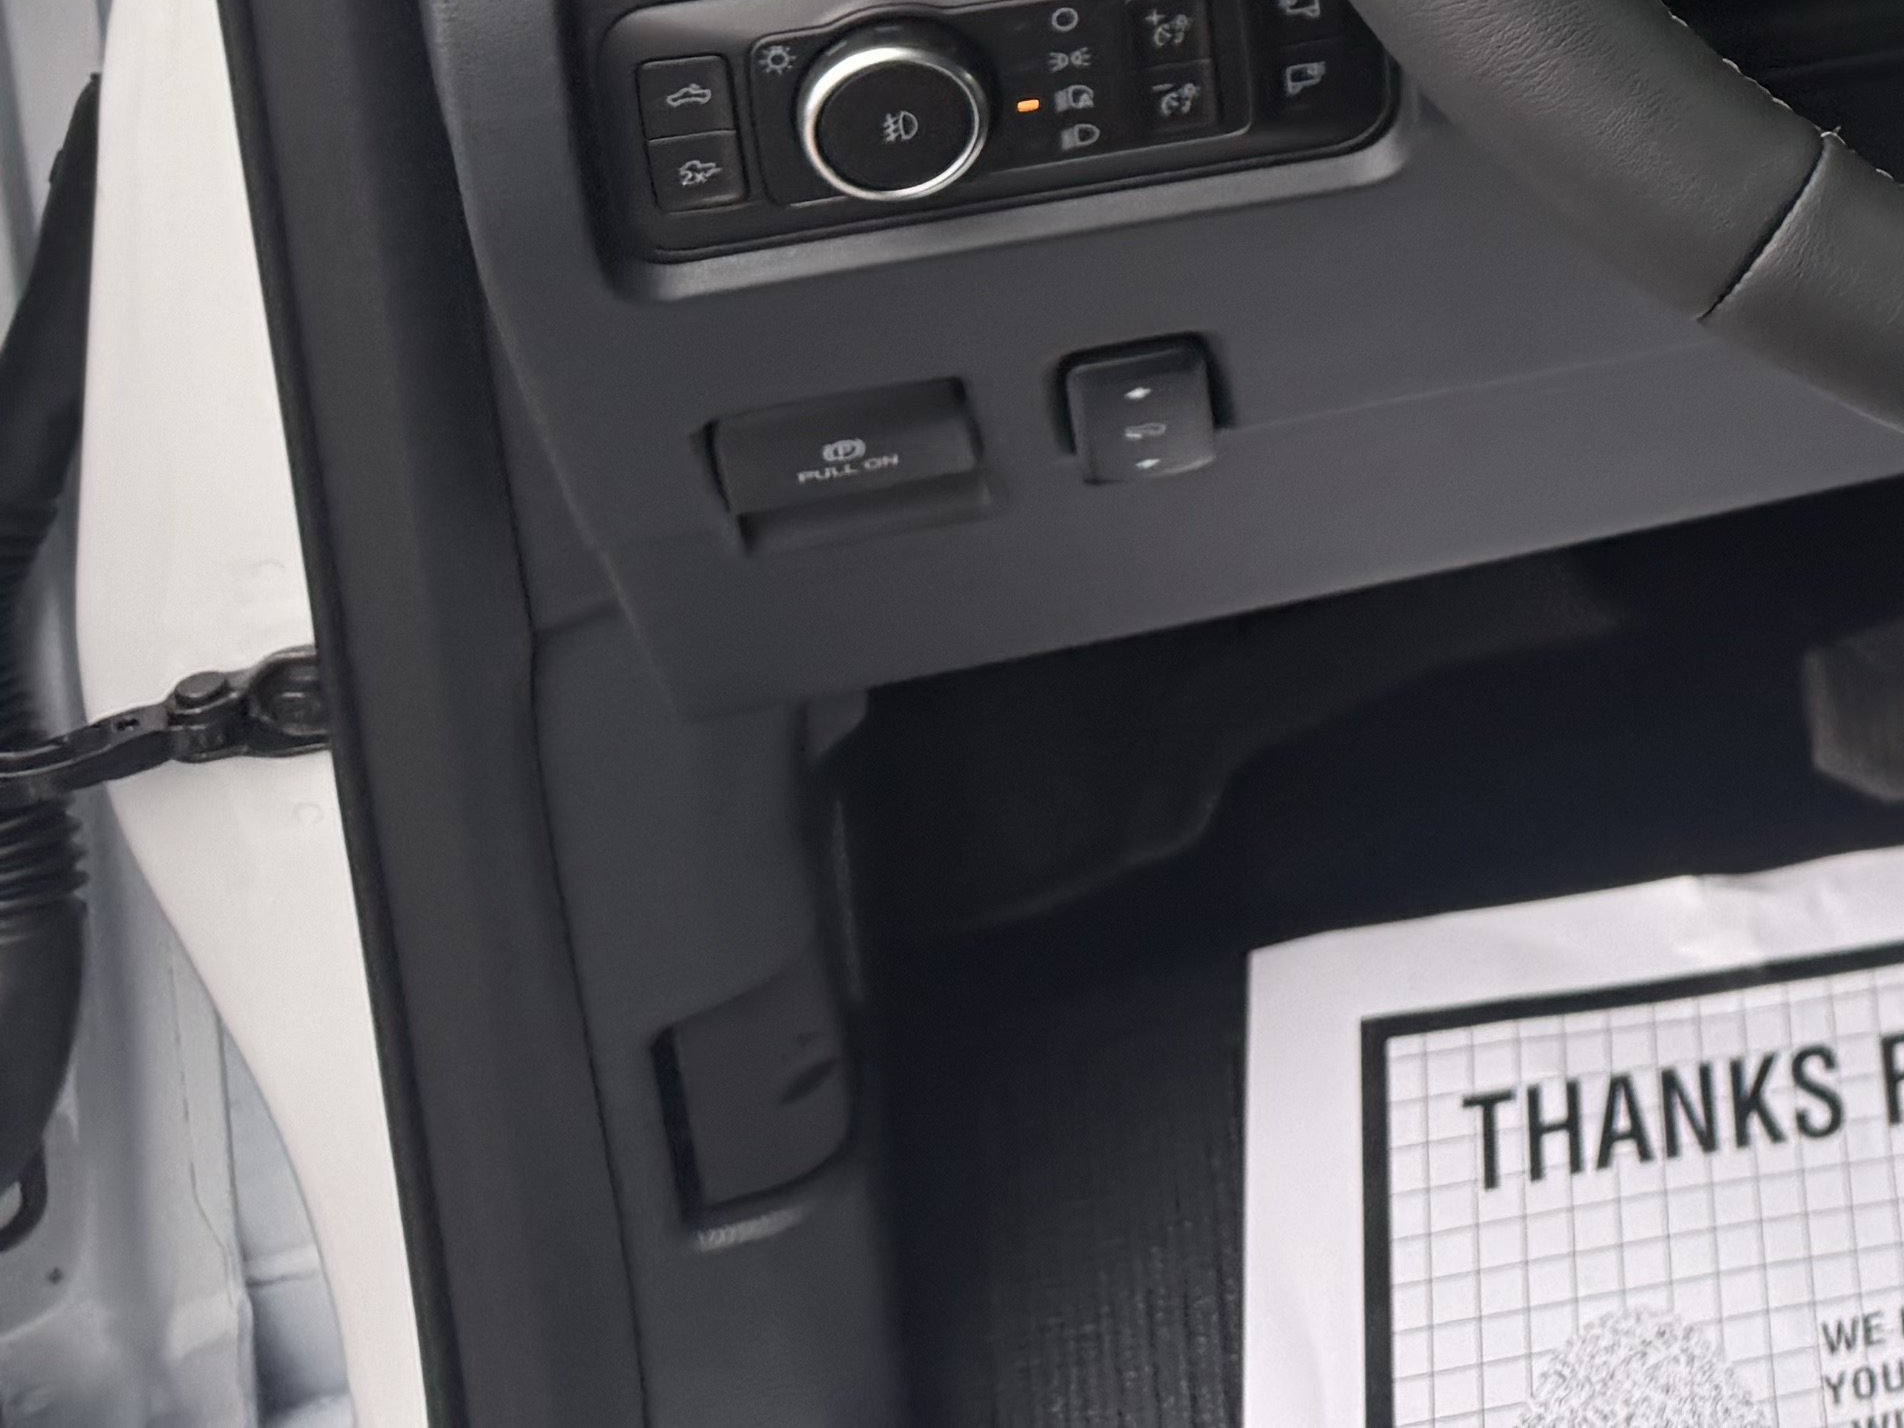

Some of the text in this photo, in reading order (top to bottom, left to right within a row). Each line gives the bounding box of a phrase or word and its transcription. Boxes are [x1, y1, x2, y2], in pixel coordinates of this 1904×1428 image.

[797, 453, 899, 483] PULL ON
[1461, 1043, 1844, 1193] THANKS
[1821, 1309, 1887, 1356] WE
